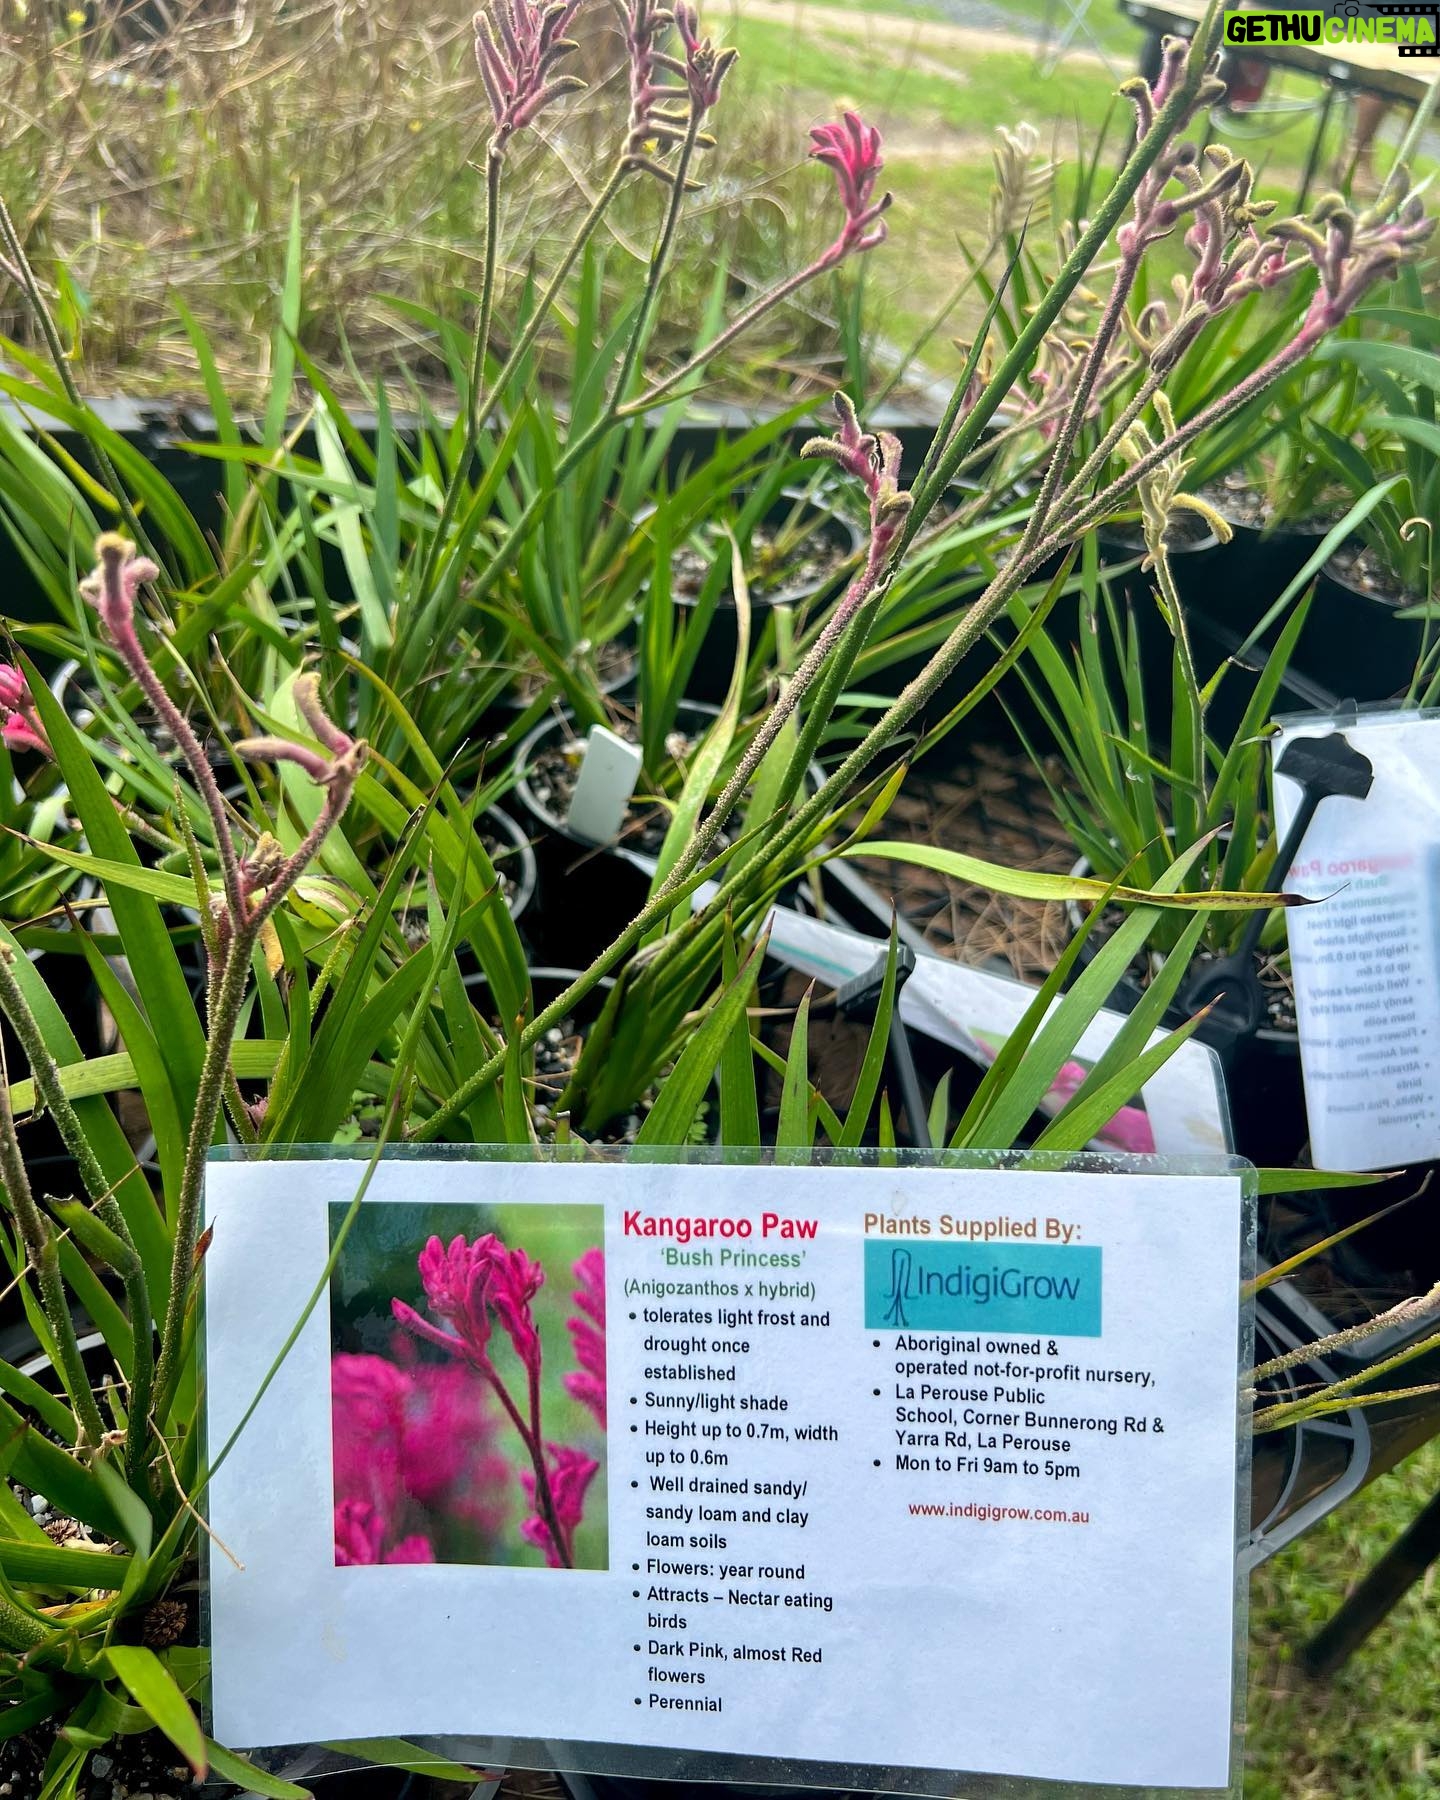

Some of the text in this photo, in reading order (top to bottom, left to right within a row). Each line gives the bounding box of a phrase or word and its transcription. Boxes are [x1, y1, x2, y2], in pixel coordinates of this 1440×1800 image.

[625, 1211, 818, 1243] Kangaroo Paw
[865, 1213, 1080, 1245] Plants Supplied By:
[625, 1279, 815, 1301] (Anigozanthos x hybrid)
[918, 1266, 1079, 1304] IndigiGrow
[644, 1308, 829, 1328] tolerates light frost and
[644, 1335, 750, 1355] drought once
[895, 1335, 1058, 1355] Aboriginal owned &
[645, 1364, 735, 1380] established
[896, 1360, 1155, 1387] operated not-for-profit nursery,
[646, 1392, 788, 1412] Sunny/light shade
[896, 1384, 1045, 1404] La Perouse Public
[646, 1420, 838, 1442] Height up to 0.7m, width
[896, 1407, 1164, 1435] School, Corner Bunnerong Rd &
[896, 1430, 1070, 1452] Yarra Rd, La Perouse
[646, 1449, 727, 1467] up to 0.6m
[896, 1455, 1079, 1480] Mon to Fri 9am to 5pm
[650, 1476, 807, 1499] Well drained sandy/
[646, 1504, 808, 1528] sandy loam and clay
[909, 1502, 1089, 1523] www.indigigrow.com.au
[647, 1531, 726, 1548] loam soils
[648, 1559, 804, 1580] Flowers: year round
[647, 1586, 708, 1603] Attracts
[729, 1589, 780, 1606] Nectar
[784, 1592, 832, 1612] eating
[648, 1613, 687, 1629] birds
[649, 1640, 821, 1663] Dark Pink, almost Red
[648, 1667, 705, 1684] flowers
[650, 1693, 721, 1712] Perennial
